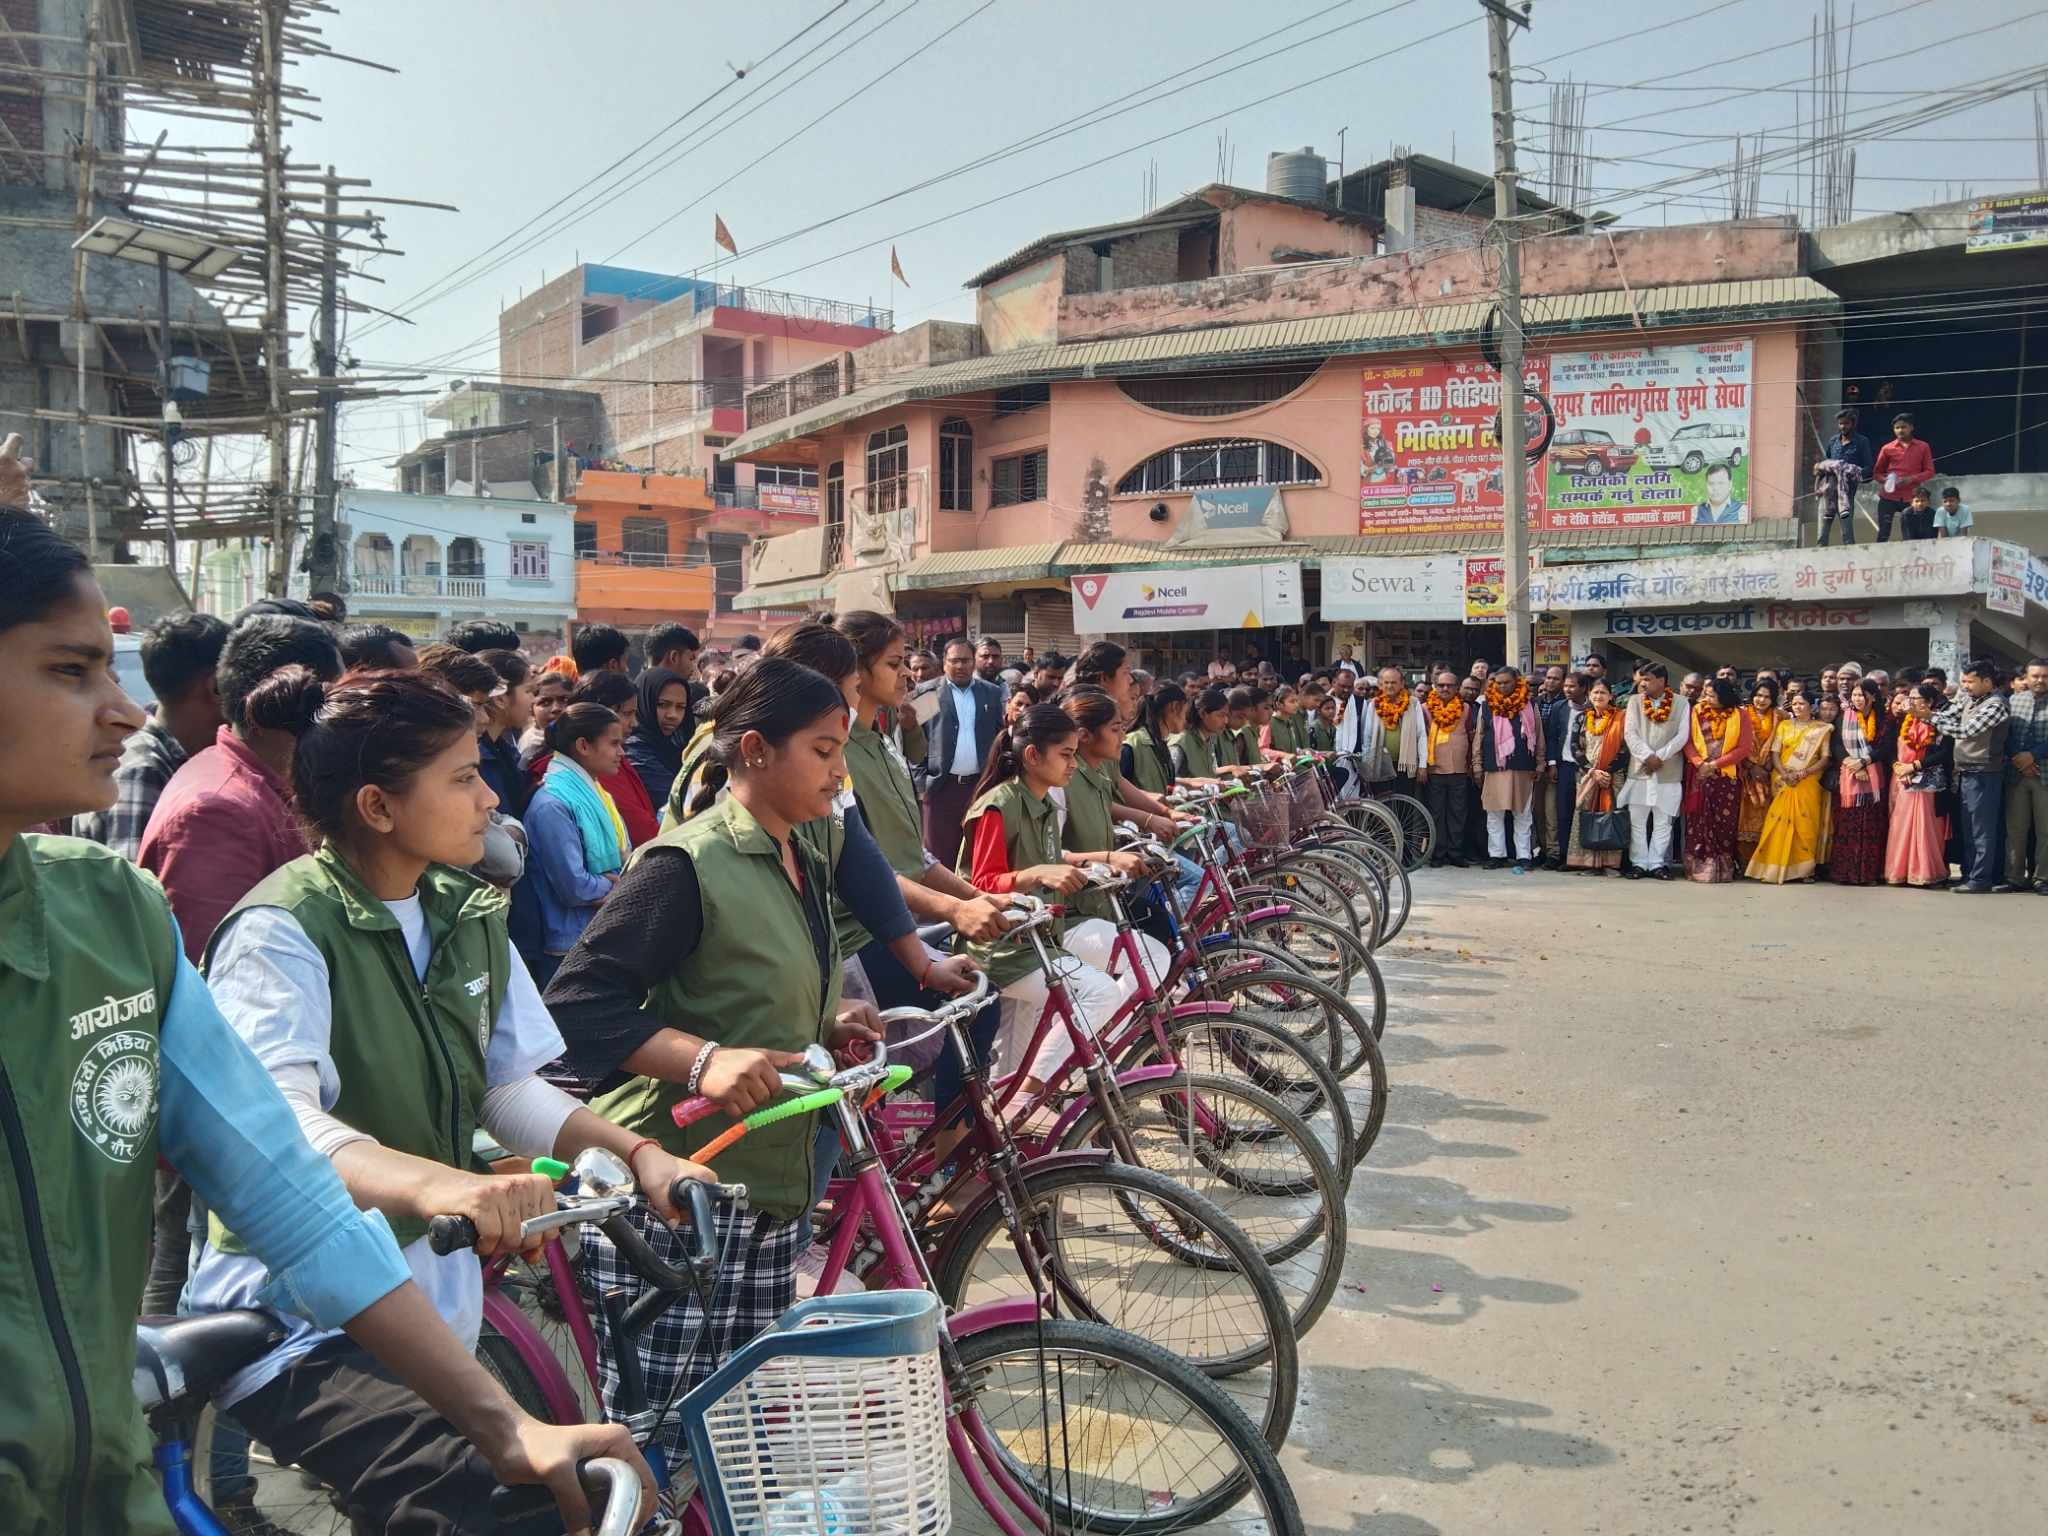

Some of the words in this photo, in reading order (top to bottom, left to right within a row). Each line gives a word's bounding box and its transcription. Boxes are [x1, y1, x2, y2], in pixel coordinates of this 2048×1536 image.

[1366, 383, 1412, 414] राजेन्द्र
[1420, 386, 1443, 411] HD
[1552, 392, 1585, 425] सुपर
[1675, 377, 1708, 420] सुमो
[1714, 376, 1746, 409] सेवा
[1217, 502, 1249, 515] Ncell
[1158, 586, 1188, 598] Ncell
[1795, 565, 1817, 588] श्री
[1823, 562, 1855, 592] दुर्गा
[1605, 605, 1757, 635] विश्वकर्मा
[1766, 603, 1872, 629] सिमेन्ट
[69, 988, 156, 1041] आयोजक
[97, 1033, 151, 1061] मिडिया
